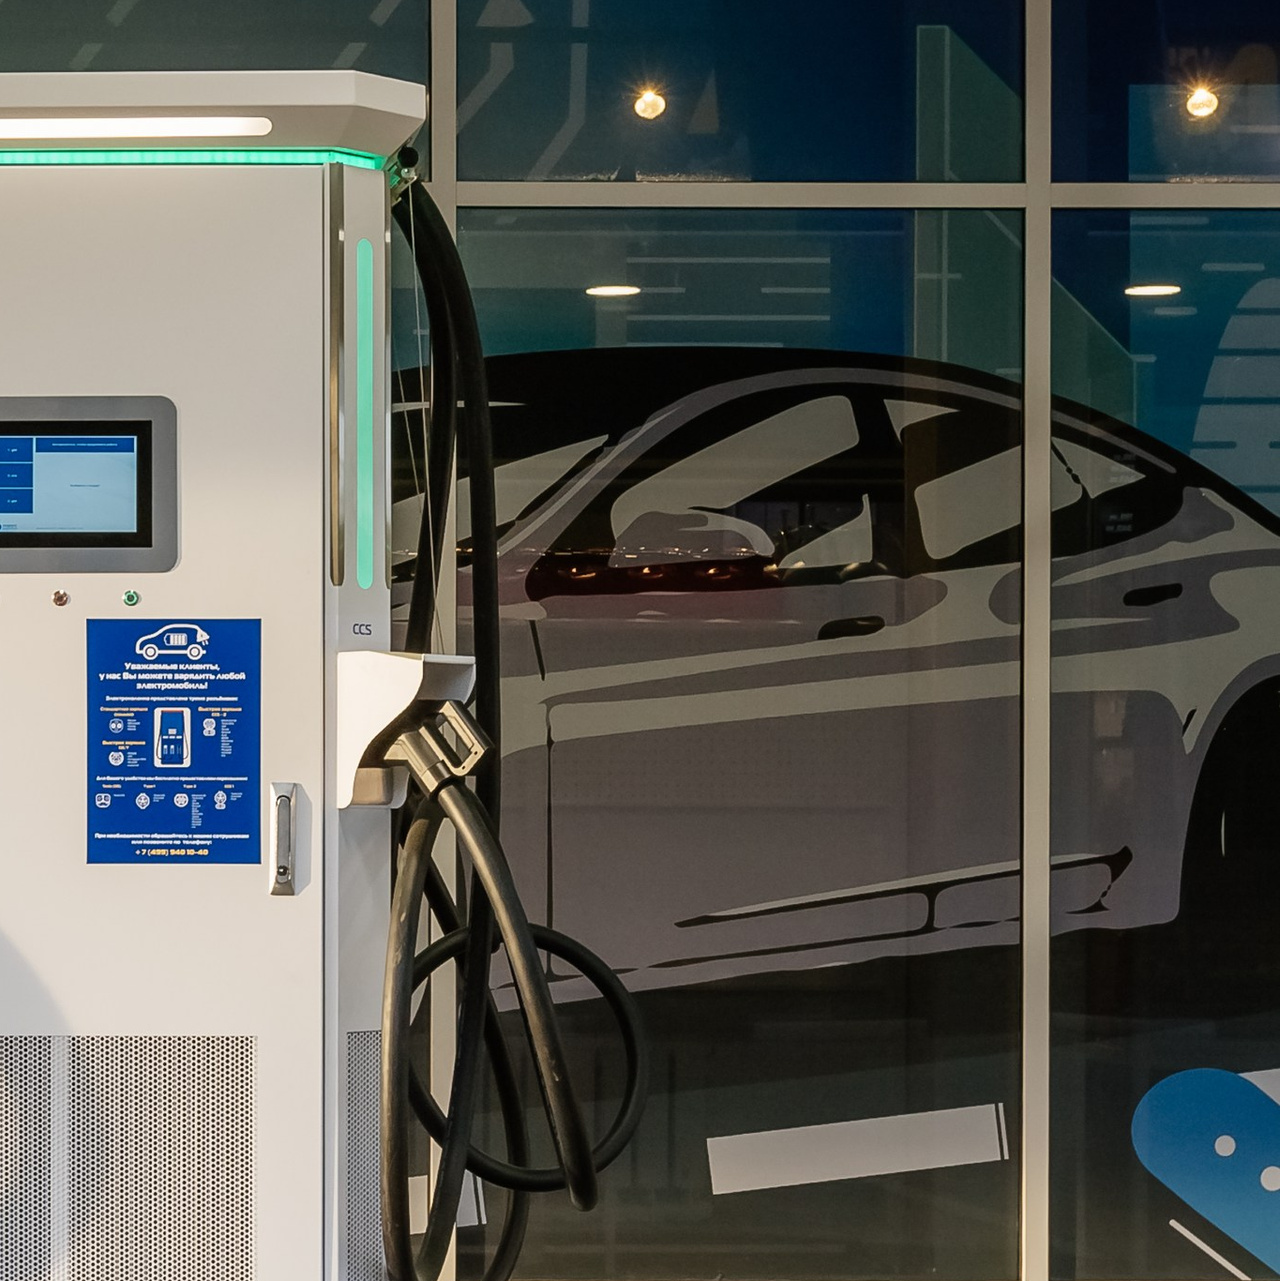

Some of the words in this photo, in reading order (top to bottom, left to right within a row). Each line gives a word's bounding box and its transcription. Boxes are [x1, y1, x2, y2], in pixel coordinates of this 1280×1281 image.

[352, 623, 373, 636] CCS
[124, 662, 179, 671] Уважаемые
[106, 672, 122, 680] нас
[216, 671, 246, 680] любой
